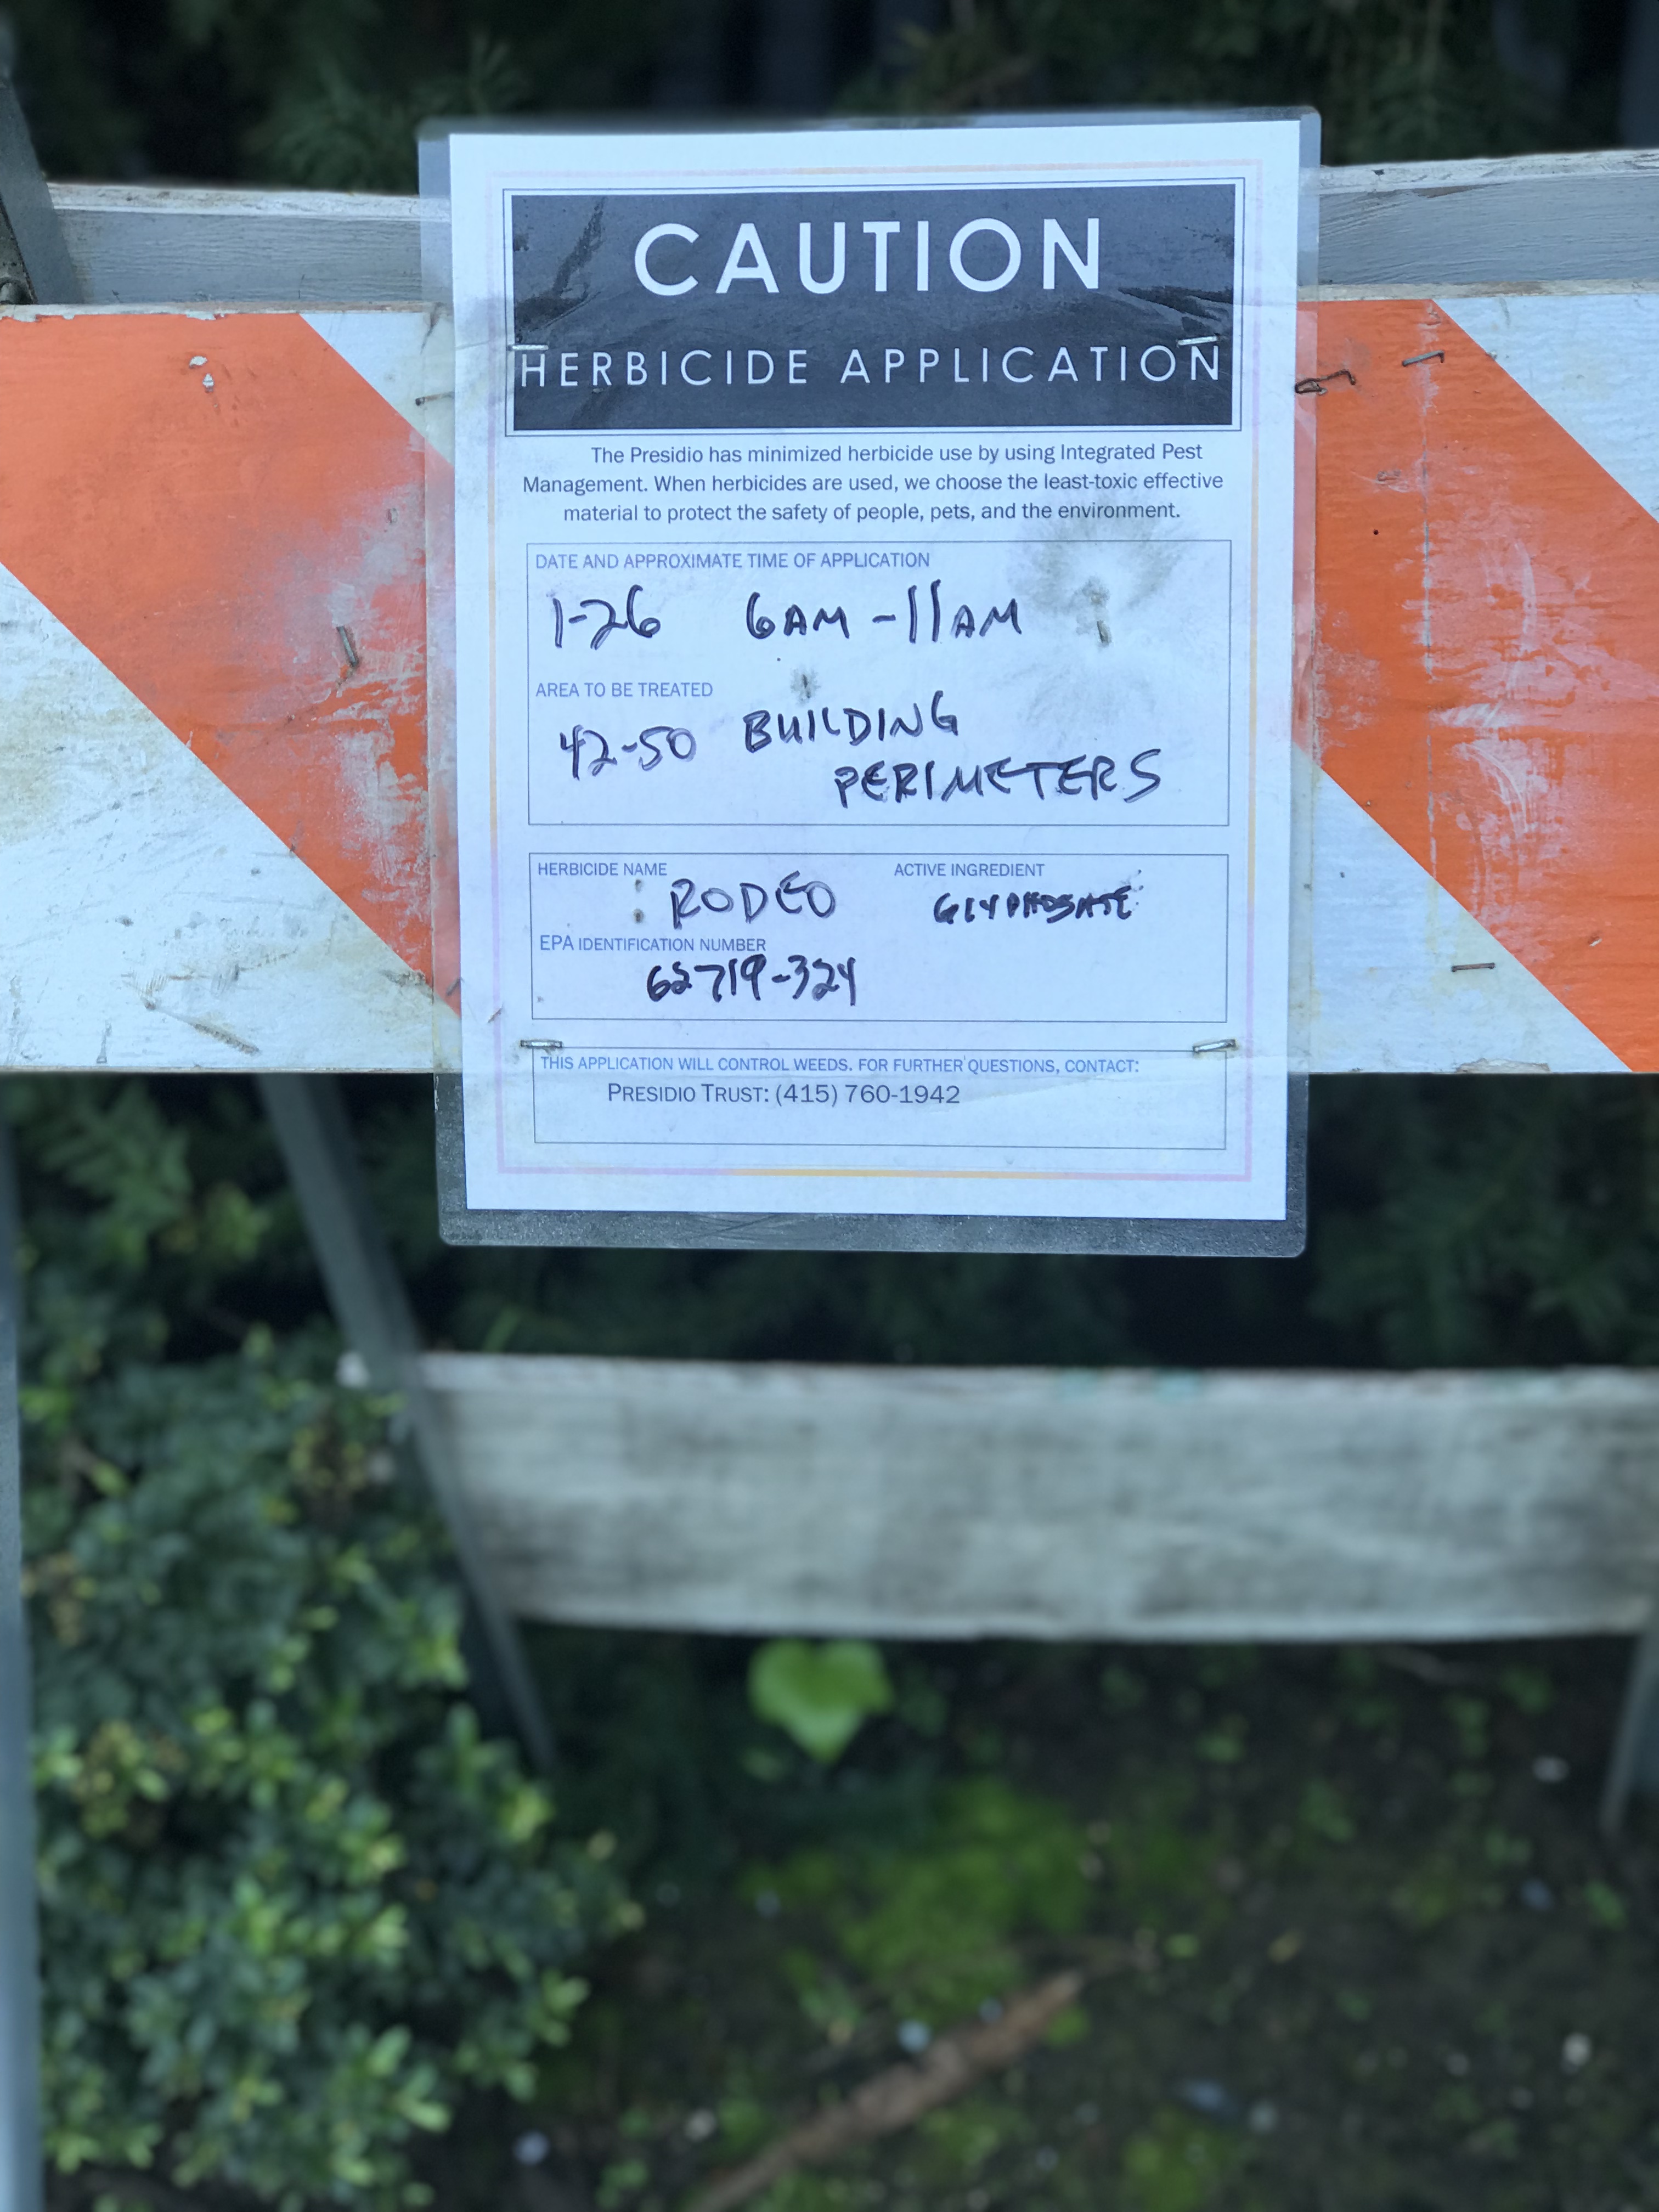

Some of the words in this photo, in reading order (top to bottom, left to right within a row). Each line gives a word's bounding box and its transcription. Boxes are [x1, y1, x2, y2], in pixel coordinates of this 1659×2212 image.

[634, 218, 1099, 296] CAUTION
[521, 349, 807, 387] HERBICIDE
[840, 343, 1218, 383] APPLICATION
[591, 447, 624, 464] The
[631, 446, 703, 464] Presidio
[709, 446, 742, 463] has
[748, 445, 842, 462] minimized
[848, 444, 934, 462] herbicide
[939, 448, 973, 461] use
[979, 444, 1000, 465] by
[1005, 444, 1056, 465] using
[1061, 443, 1155, 464] Integrated
[1163, 443, 1203, 460] Pest
[523, 476, 648, 496] Management.
[653, 475, 706, 492] When
[712, 474, 807, 492] herbicides
[812, 477, 843, 491] are
[849, 473, 898, 493] used,
[904, 477, 930, 490] we
[935, 473, 1002, 490] choose
[1007, 473, 1038, 490] the
[1043, 472, 1138, 490] least-toxic
[1143, 472, 1223, 489] effective
[564, 504, 637, 521] material
[643, 505, 662, 521] to
[668, 505, 732, 524] protect
[736, 504, 767, 521] the
[772, 503, 828, 524] safety
[833, 503, 852, 520] of
[857, 503, 924, 523] people,
[930, 504, 975, 523] pets,
[981, 502, 1016, 520] and
[1021, 502, 1052, 519] the
[1058, 501, 1181, 519] environment.
[536, 554, 578, 569] DATE
[583, 554, 619, 569] AND
[623, 552, 743, 569] APPROXIMATE
[747, 552, 789, 568] TIME
[793, 552, 816, 569] OF
[820, 552, 930, 568] APPLICATION
[546, 584, 661, 651] 1-26
[535, 682, 580, 698] AREA
[584, 682, 606, 698] TO
[611, 682, 633, 698] BE
[637, 682, 713, 698] TREATED
[559, 724, 697, 781] 42-50
[742, 688, 959, 754] BUILDING
[834, 748, 1162, 809] PERIMETERS
[538, 862, 619, 876] HERBICIDE
[625, 862, 668, 876] NAME
[894, 862, 947, 877] ACTIVE
[951, 862, 1046, 877] INGREDIENT
[669, 870, 837, 930] RODEO
[540, 934, 575, 951] EPA
[578, 937, 695, 952] IDENTIFICATION
[699, 938, 766, 952] NUMBER
[540, 1056, 574, 1070] THIS
[578, 1056, 673, 1071] APPLICATION
[678, 1057, 714, 1071] WILL
[718, 1057, 790, 1071] CONTROL
[793, 1058, 853, 1071] WEEDS.
[859, 1058, 888, 1072] FOR
[893, 1058, 963, 1073] FURTHER
[968, 1059, 1060, 1075] QUESTIONS,
[1064, 1059, 1139, 1073] CONTACT:
[776, 1084, 838, 1108] (415)
[845, 1084, 960, 1104] 760-1942
